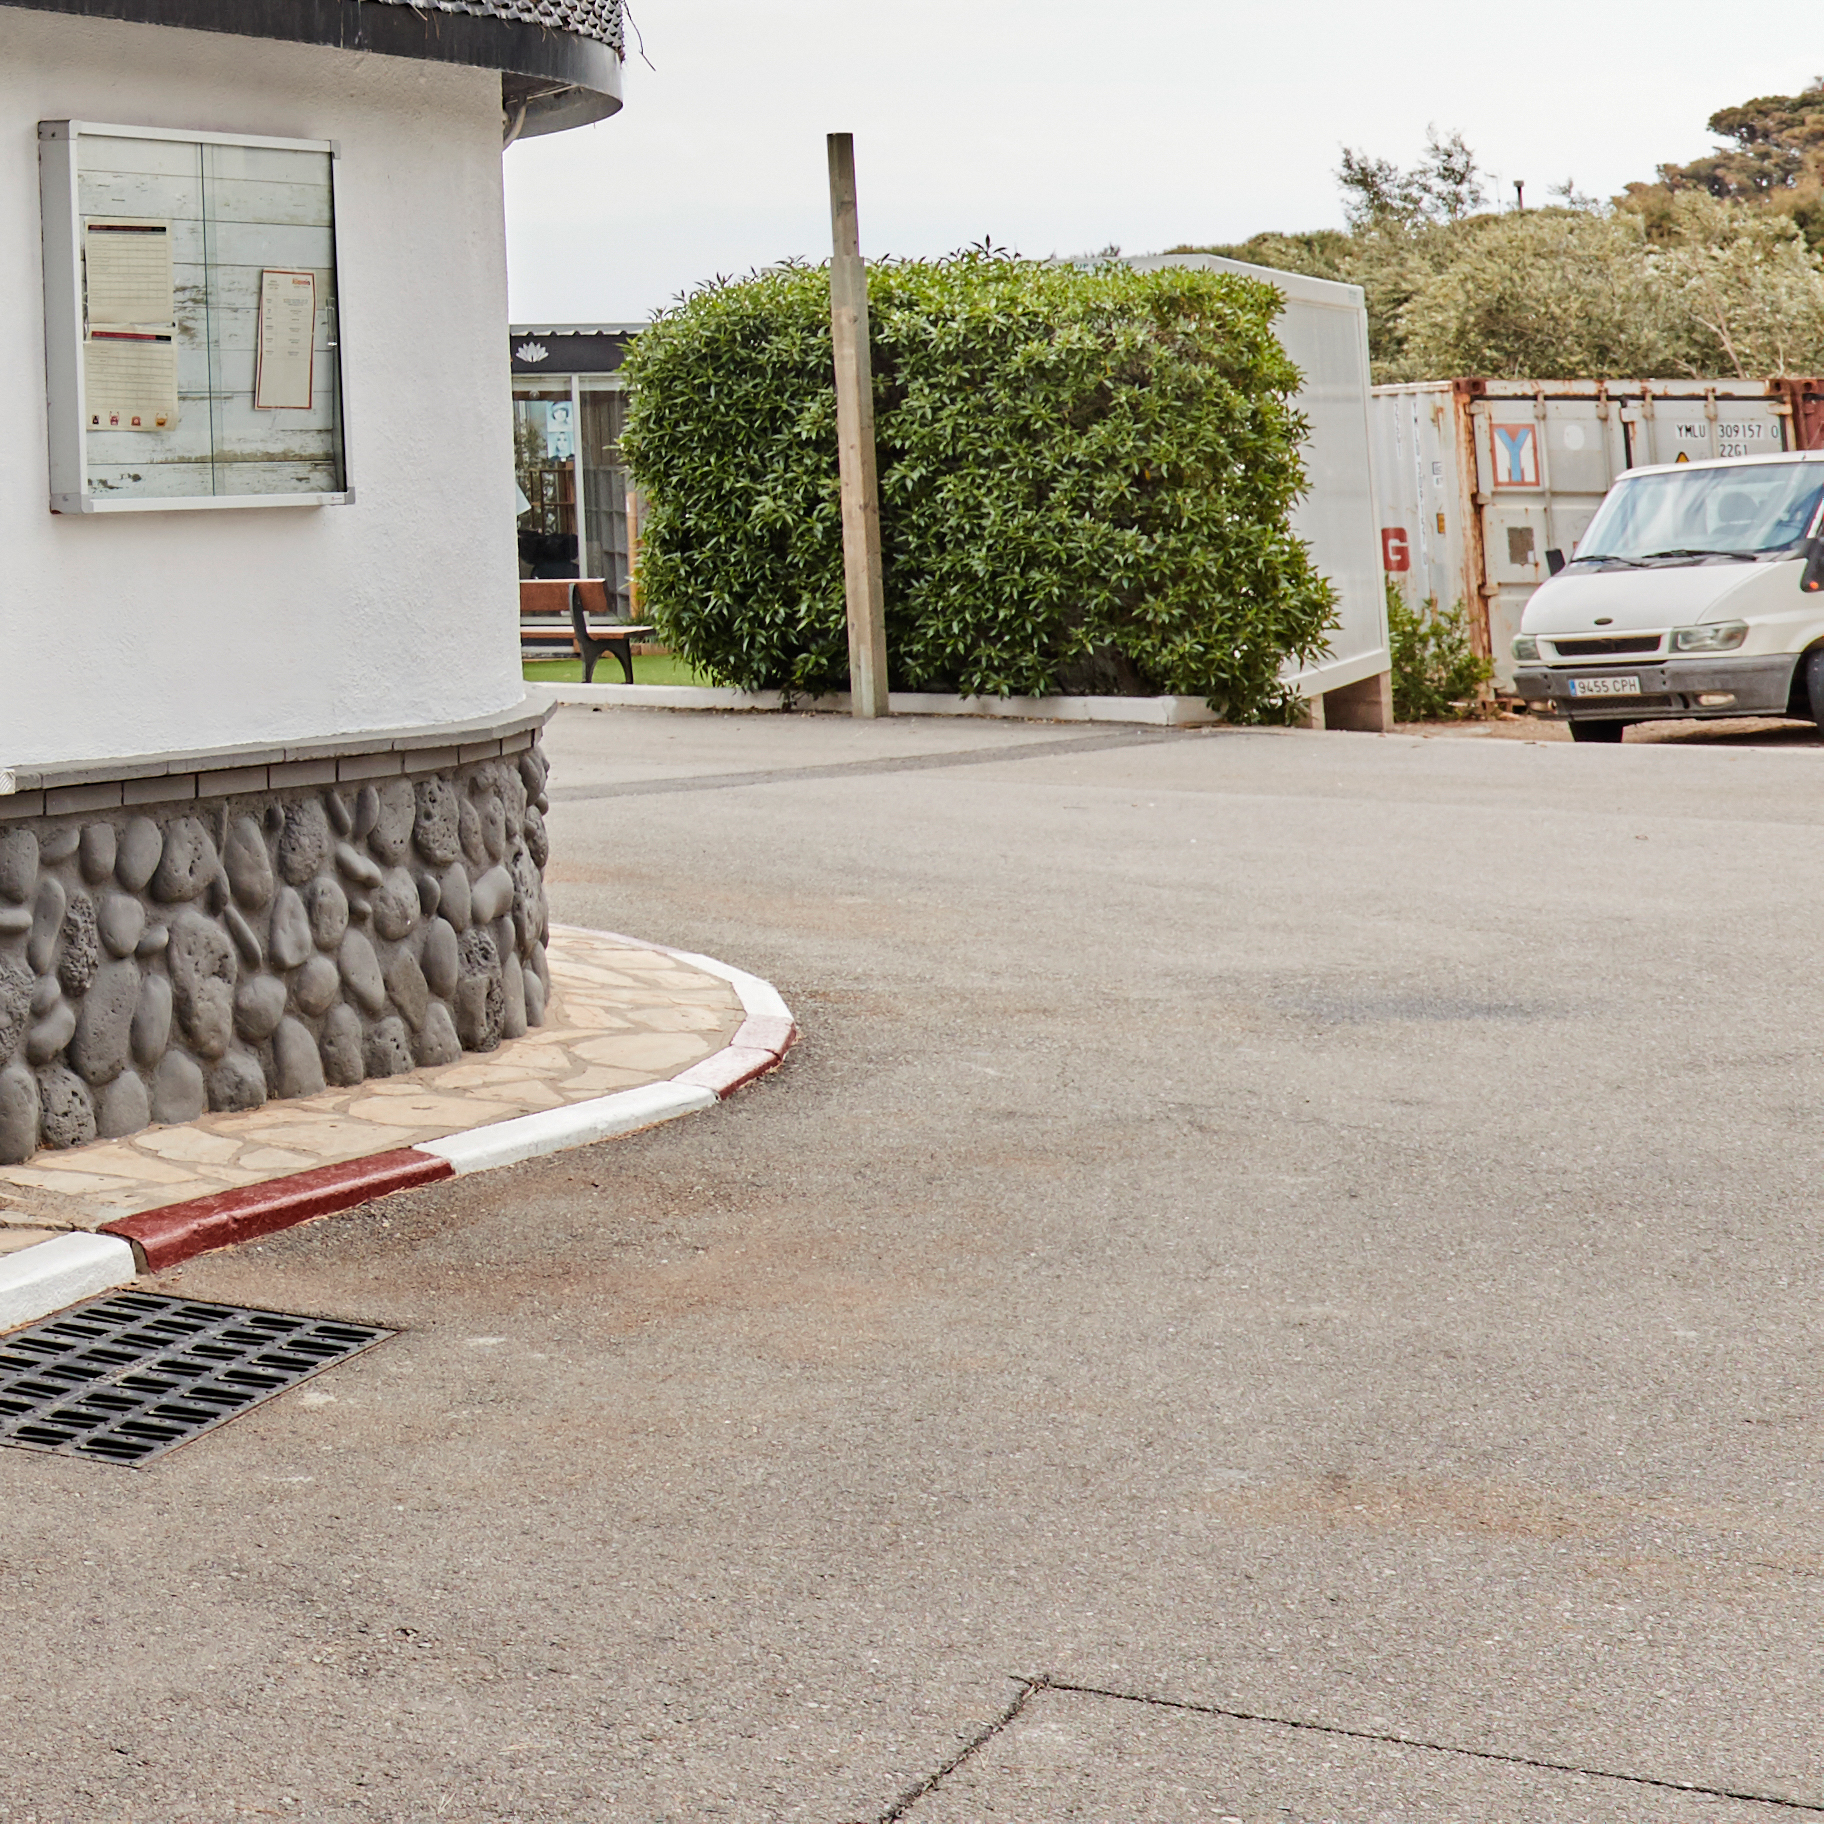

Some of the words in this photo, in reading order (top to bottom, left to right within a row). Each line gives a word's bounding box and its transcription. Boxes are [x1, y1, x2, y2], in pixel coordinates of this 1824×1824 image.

[1676, 424, 1706, 438] YMLU
[1718, 424, 1762, 438] 309157
[1771, 425, 1779, 439] 0
[1719, 443, 1748, 457] 22G1
[1578, 680, 1609, 694] 9455
[1613, 679, 1637, 692] CPH
